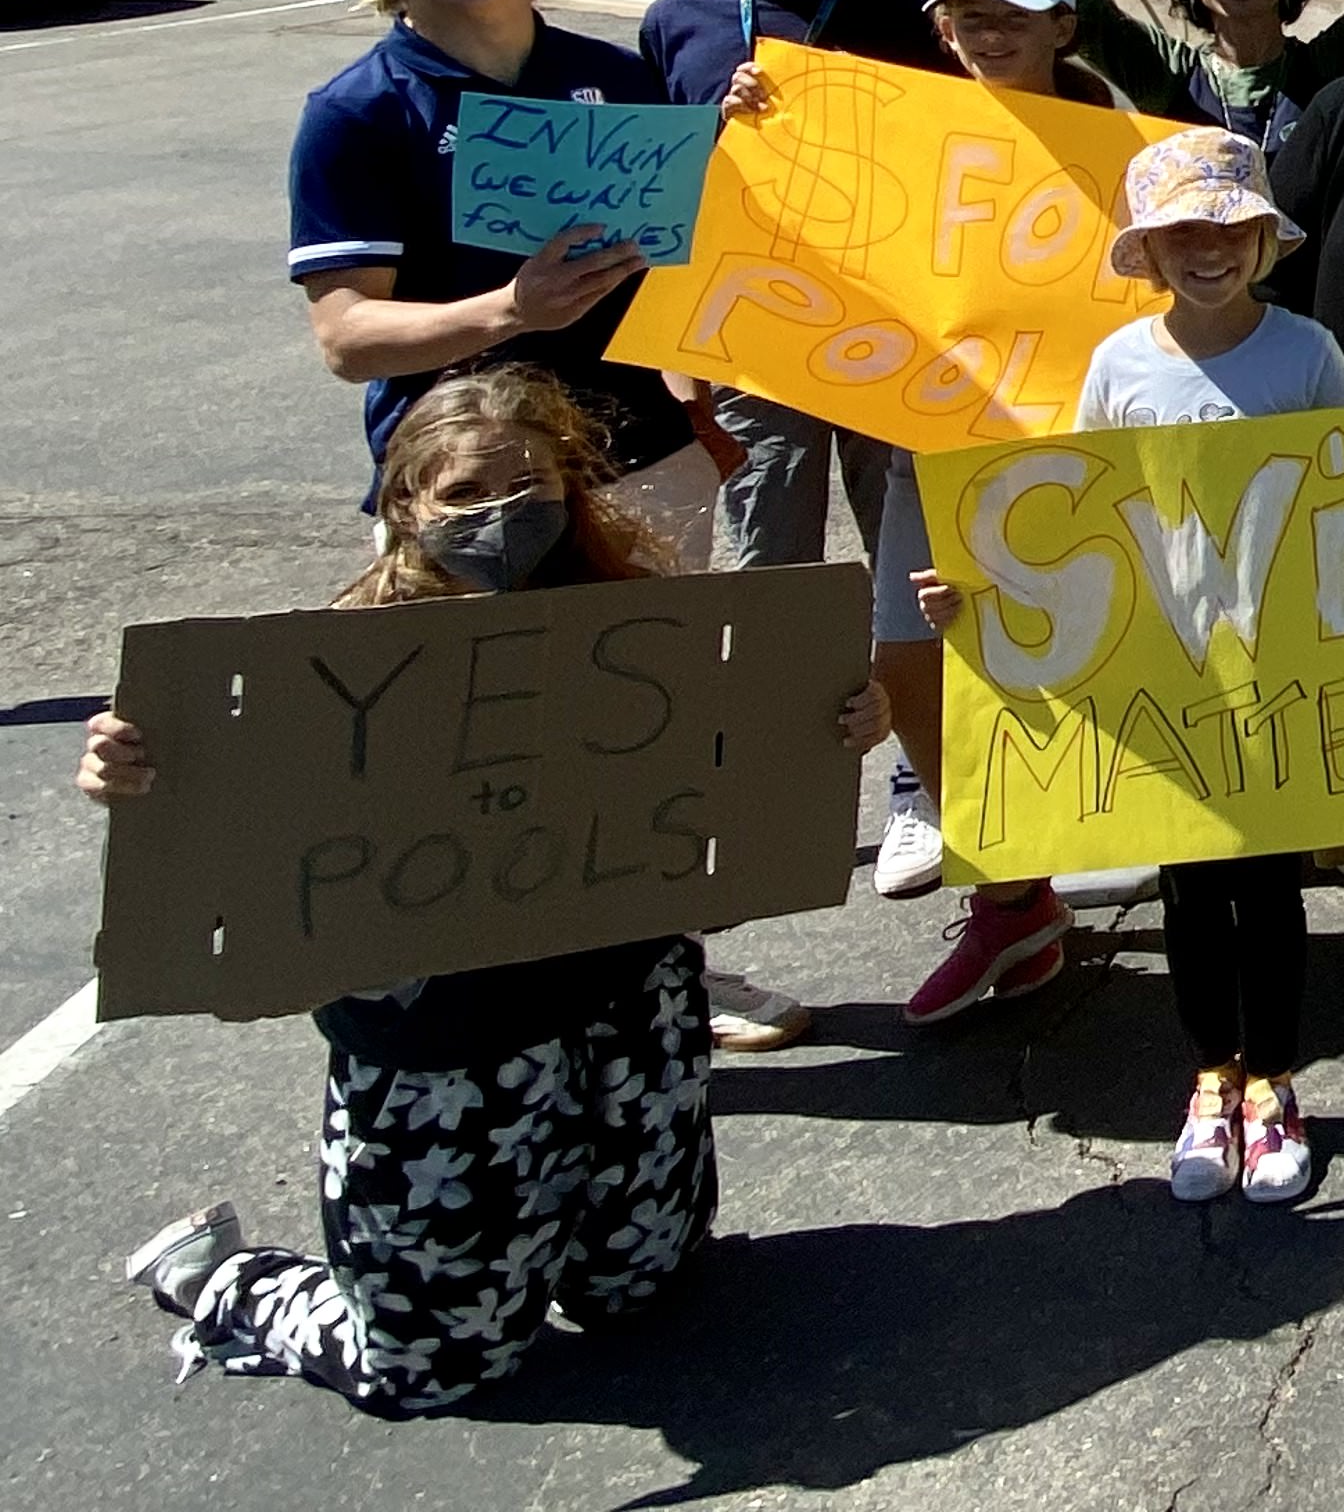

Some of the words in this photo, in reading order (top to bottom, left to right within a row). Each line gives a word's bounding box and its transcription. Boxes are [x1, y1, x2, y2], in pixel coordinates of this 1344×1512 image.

[466, 98, 580, 155] IN
[307, 616, 692, 780] YES
[469, 780, 528, 814] to
[296, 787, 708, 939] POOLS
